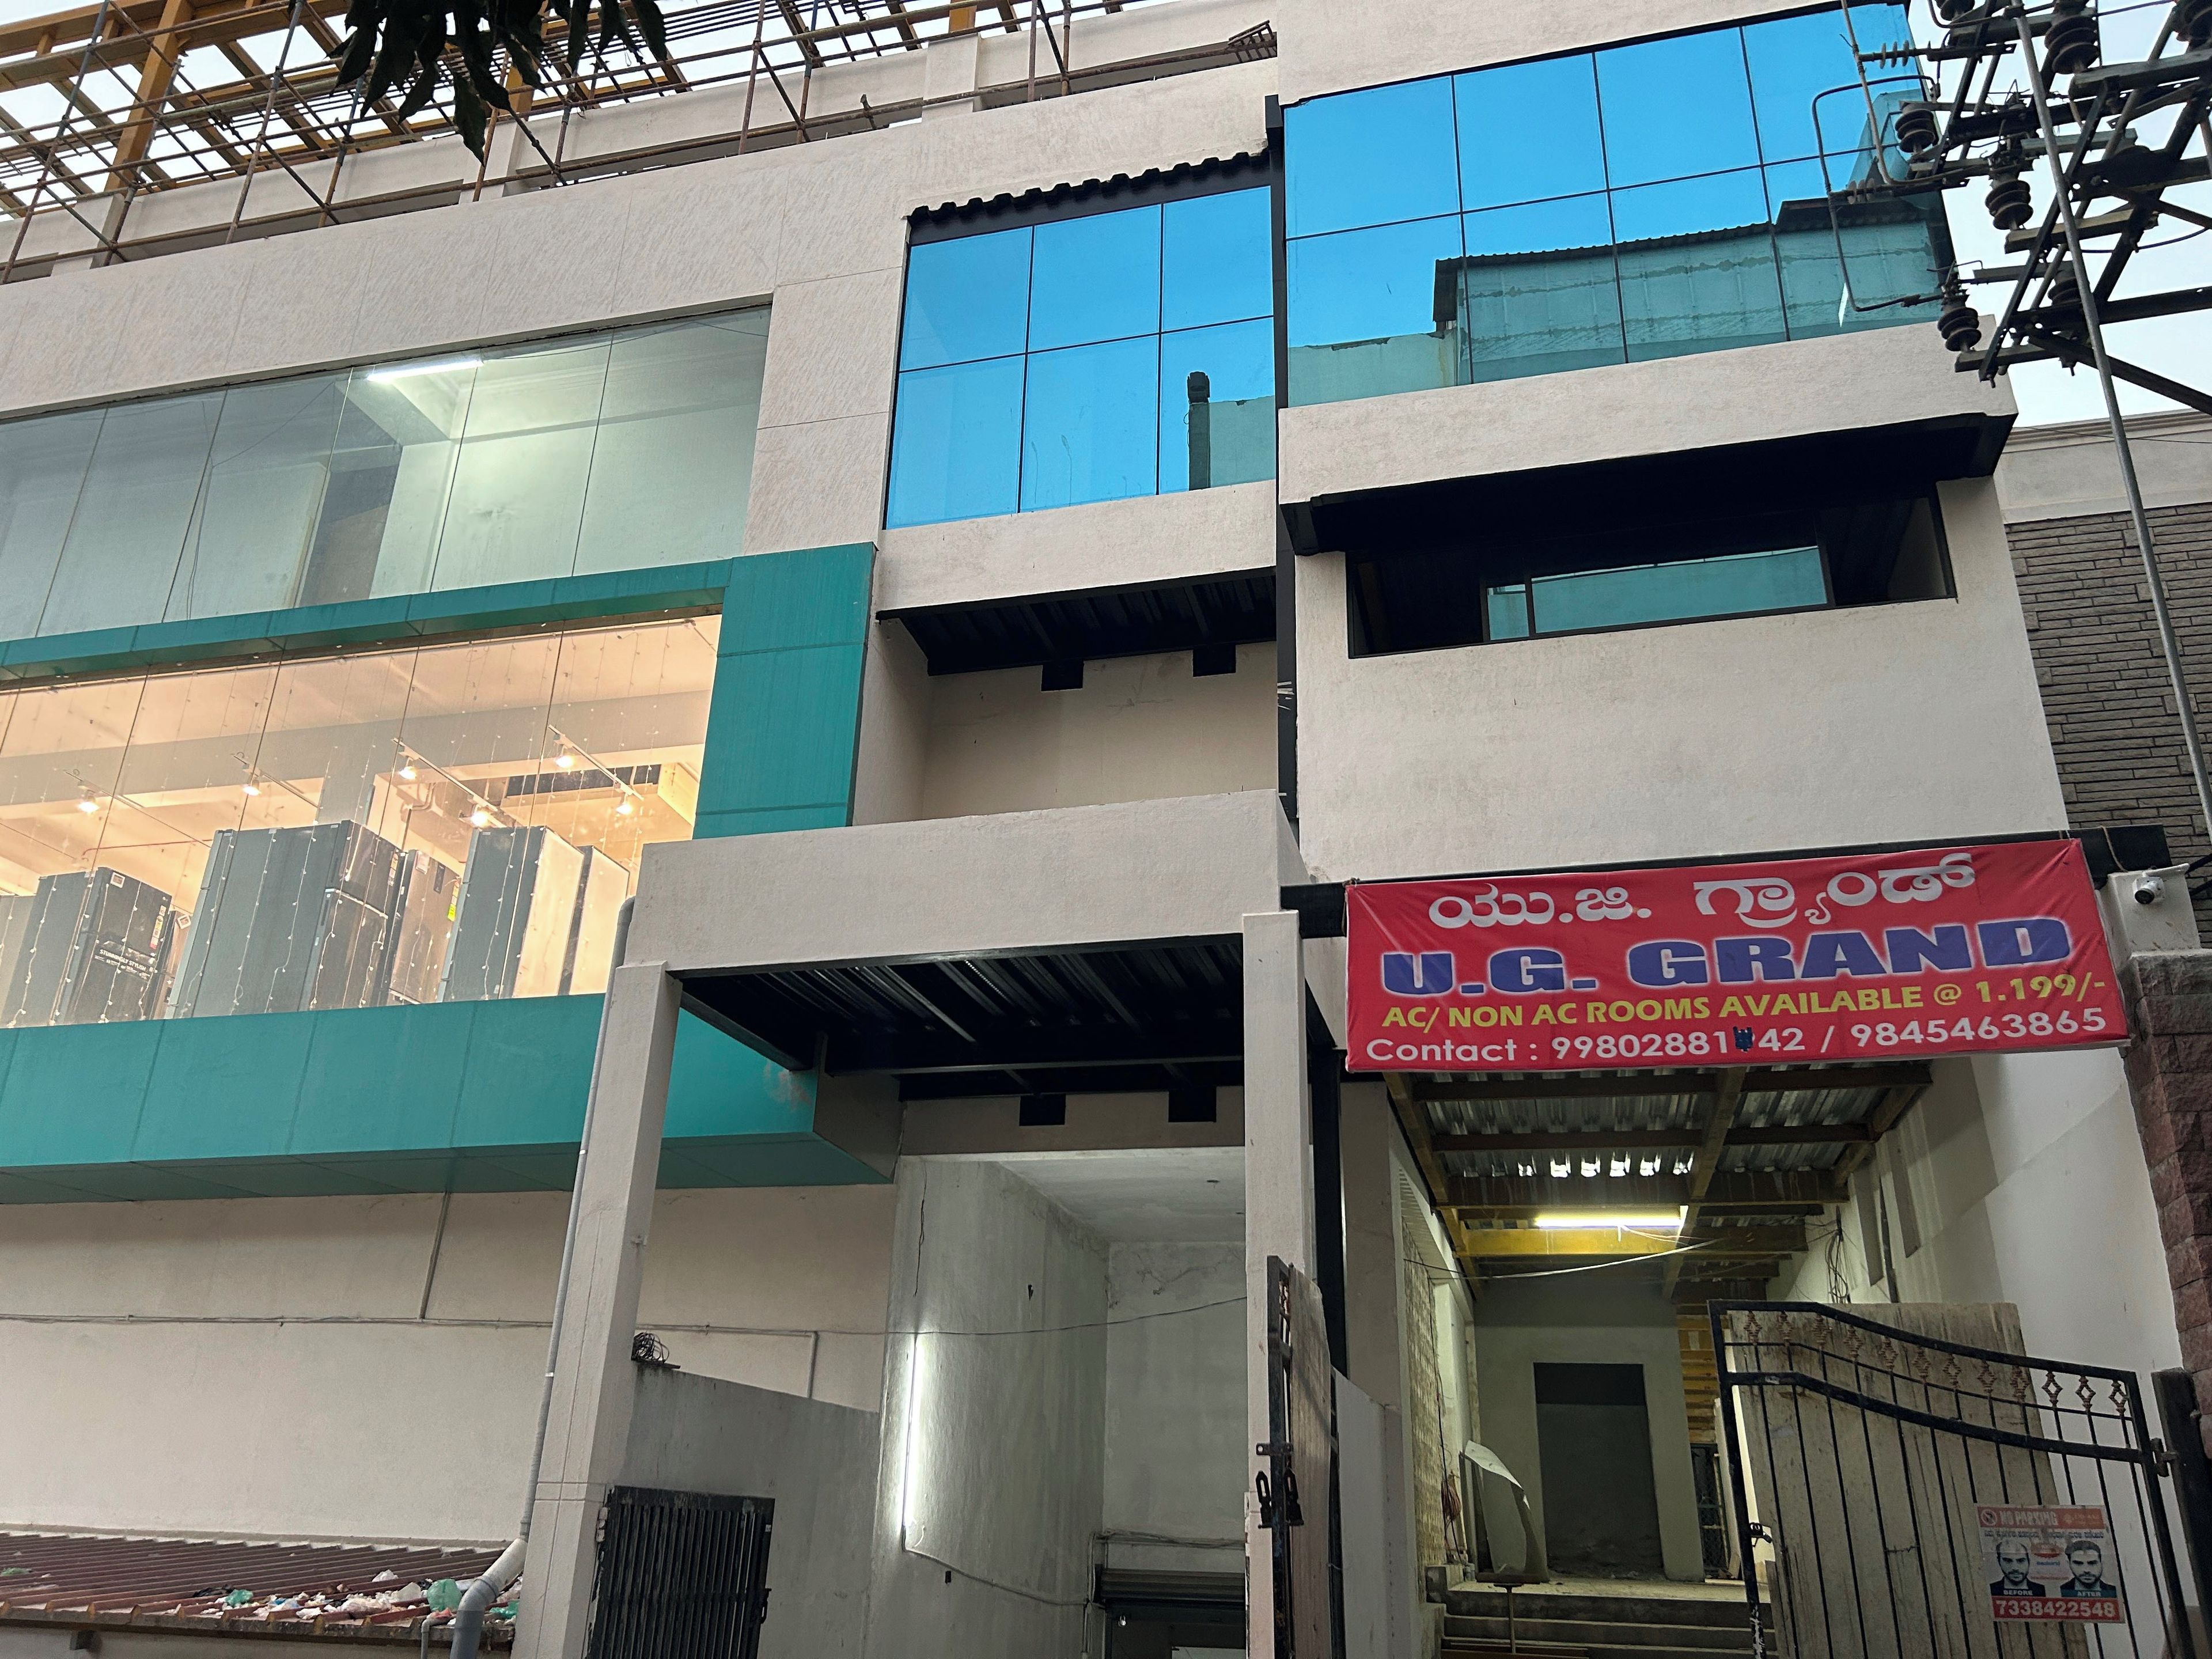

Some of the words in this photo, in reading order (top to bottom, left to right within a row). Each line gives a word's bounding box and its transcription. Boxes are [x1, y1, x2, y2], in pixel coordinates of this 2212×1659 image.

[1381, 947, 1597, 997] U.G.
[1628, 916, 2071, 987] GRAND
[1382, 1006, 1440, 1034] AC/
[1449, 1005, 1524, 1027] NON
[1531, 1002, 1577, 1025] AC
[1586, 997, 1710, 1022] ROOMS
[1718, 986, 1924, 1018] AVAILABLE
[1933, 983, 1961, 1006] @
[1976, 972, 2106, 1003] 1.199/-
[1366, 1037, 1517, 1062] Contact
[1551, 1027, 1806, 1060] 9980288142
[1850, 1007, 2106, 1047] 9845463865
[1995, 1600, 2116, 1618] 7338422548
